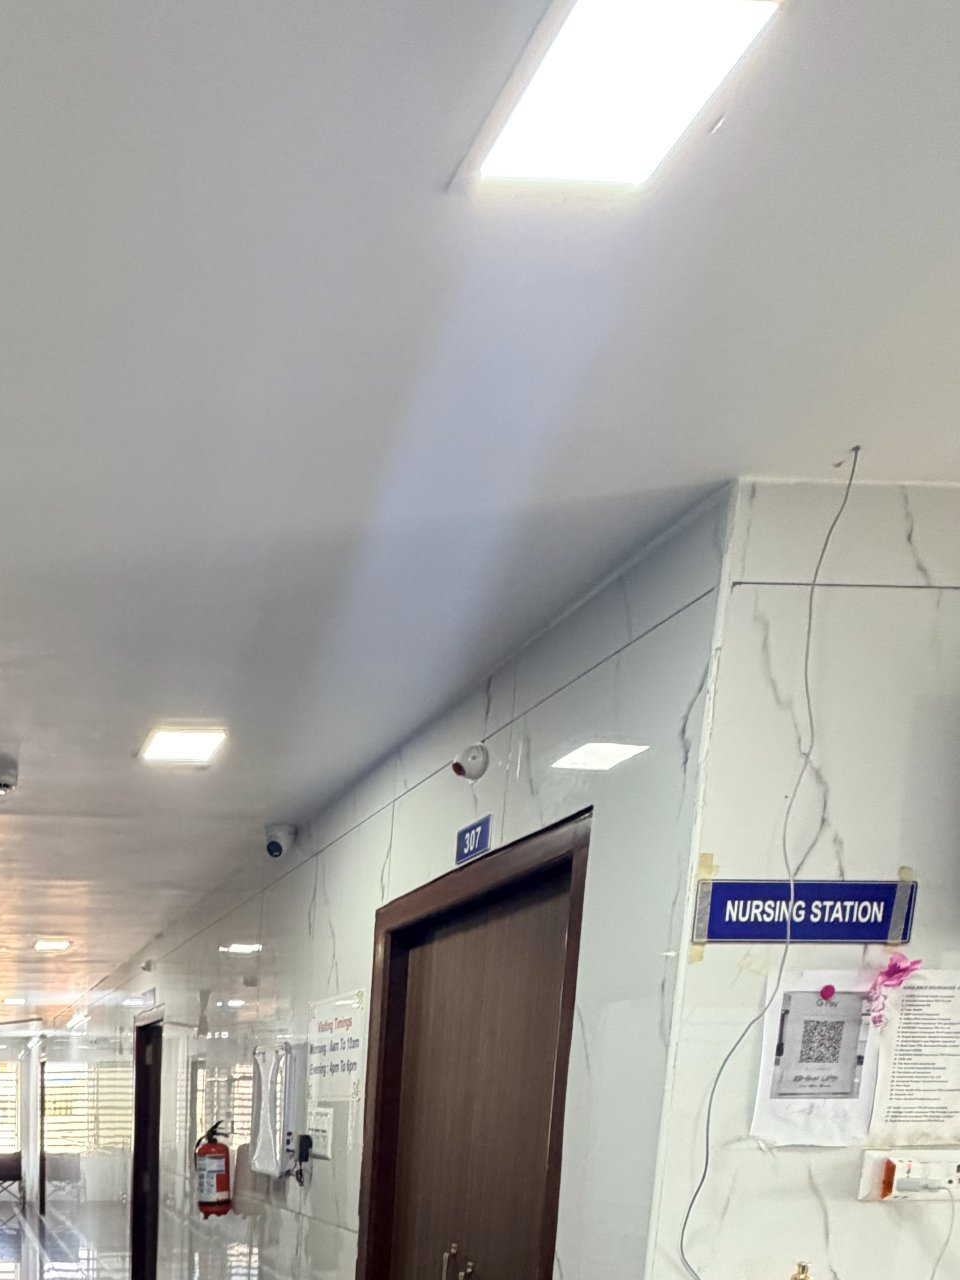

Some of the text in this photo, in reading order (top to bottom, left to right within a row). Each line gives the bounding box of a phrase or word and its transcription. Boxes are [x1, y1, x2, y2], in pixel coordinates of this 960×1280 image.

[464, 826, 482, 854] 307
[725, 900, 885, 923] NURSING STATION
[318, 1017, 353, 1033] Visiting Timings
[340, 1038, 346, 1050] To
[310, 1063, 326, 1077] Evening
[330, 1062, 339, 1076] 4pm
[340, 1060, 346, 1072] To
